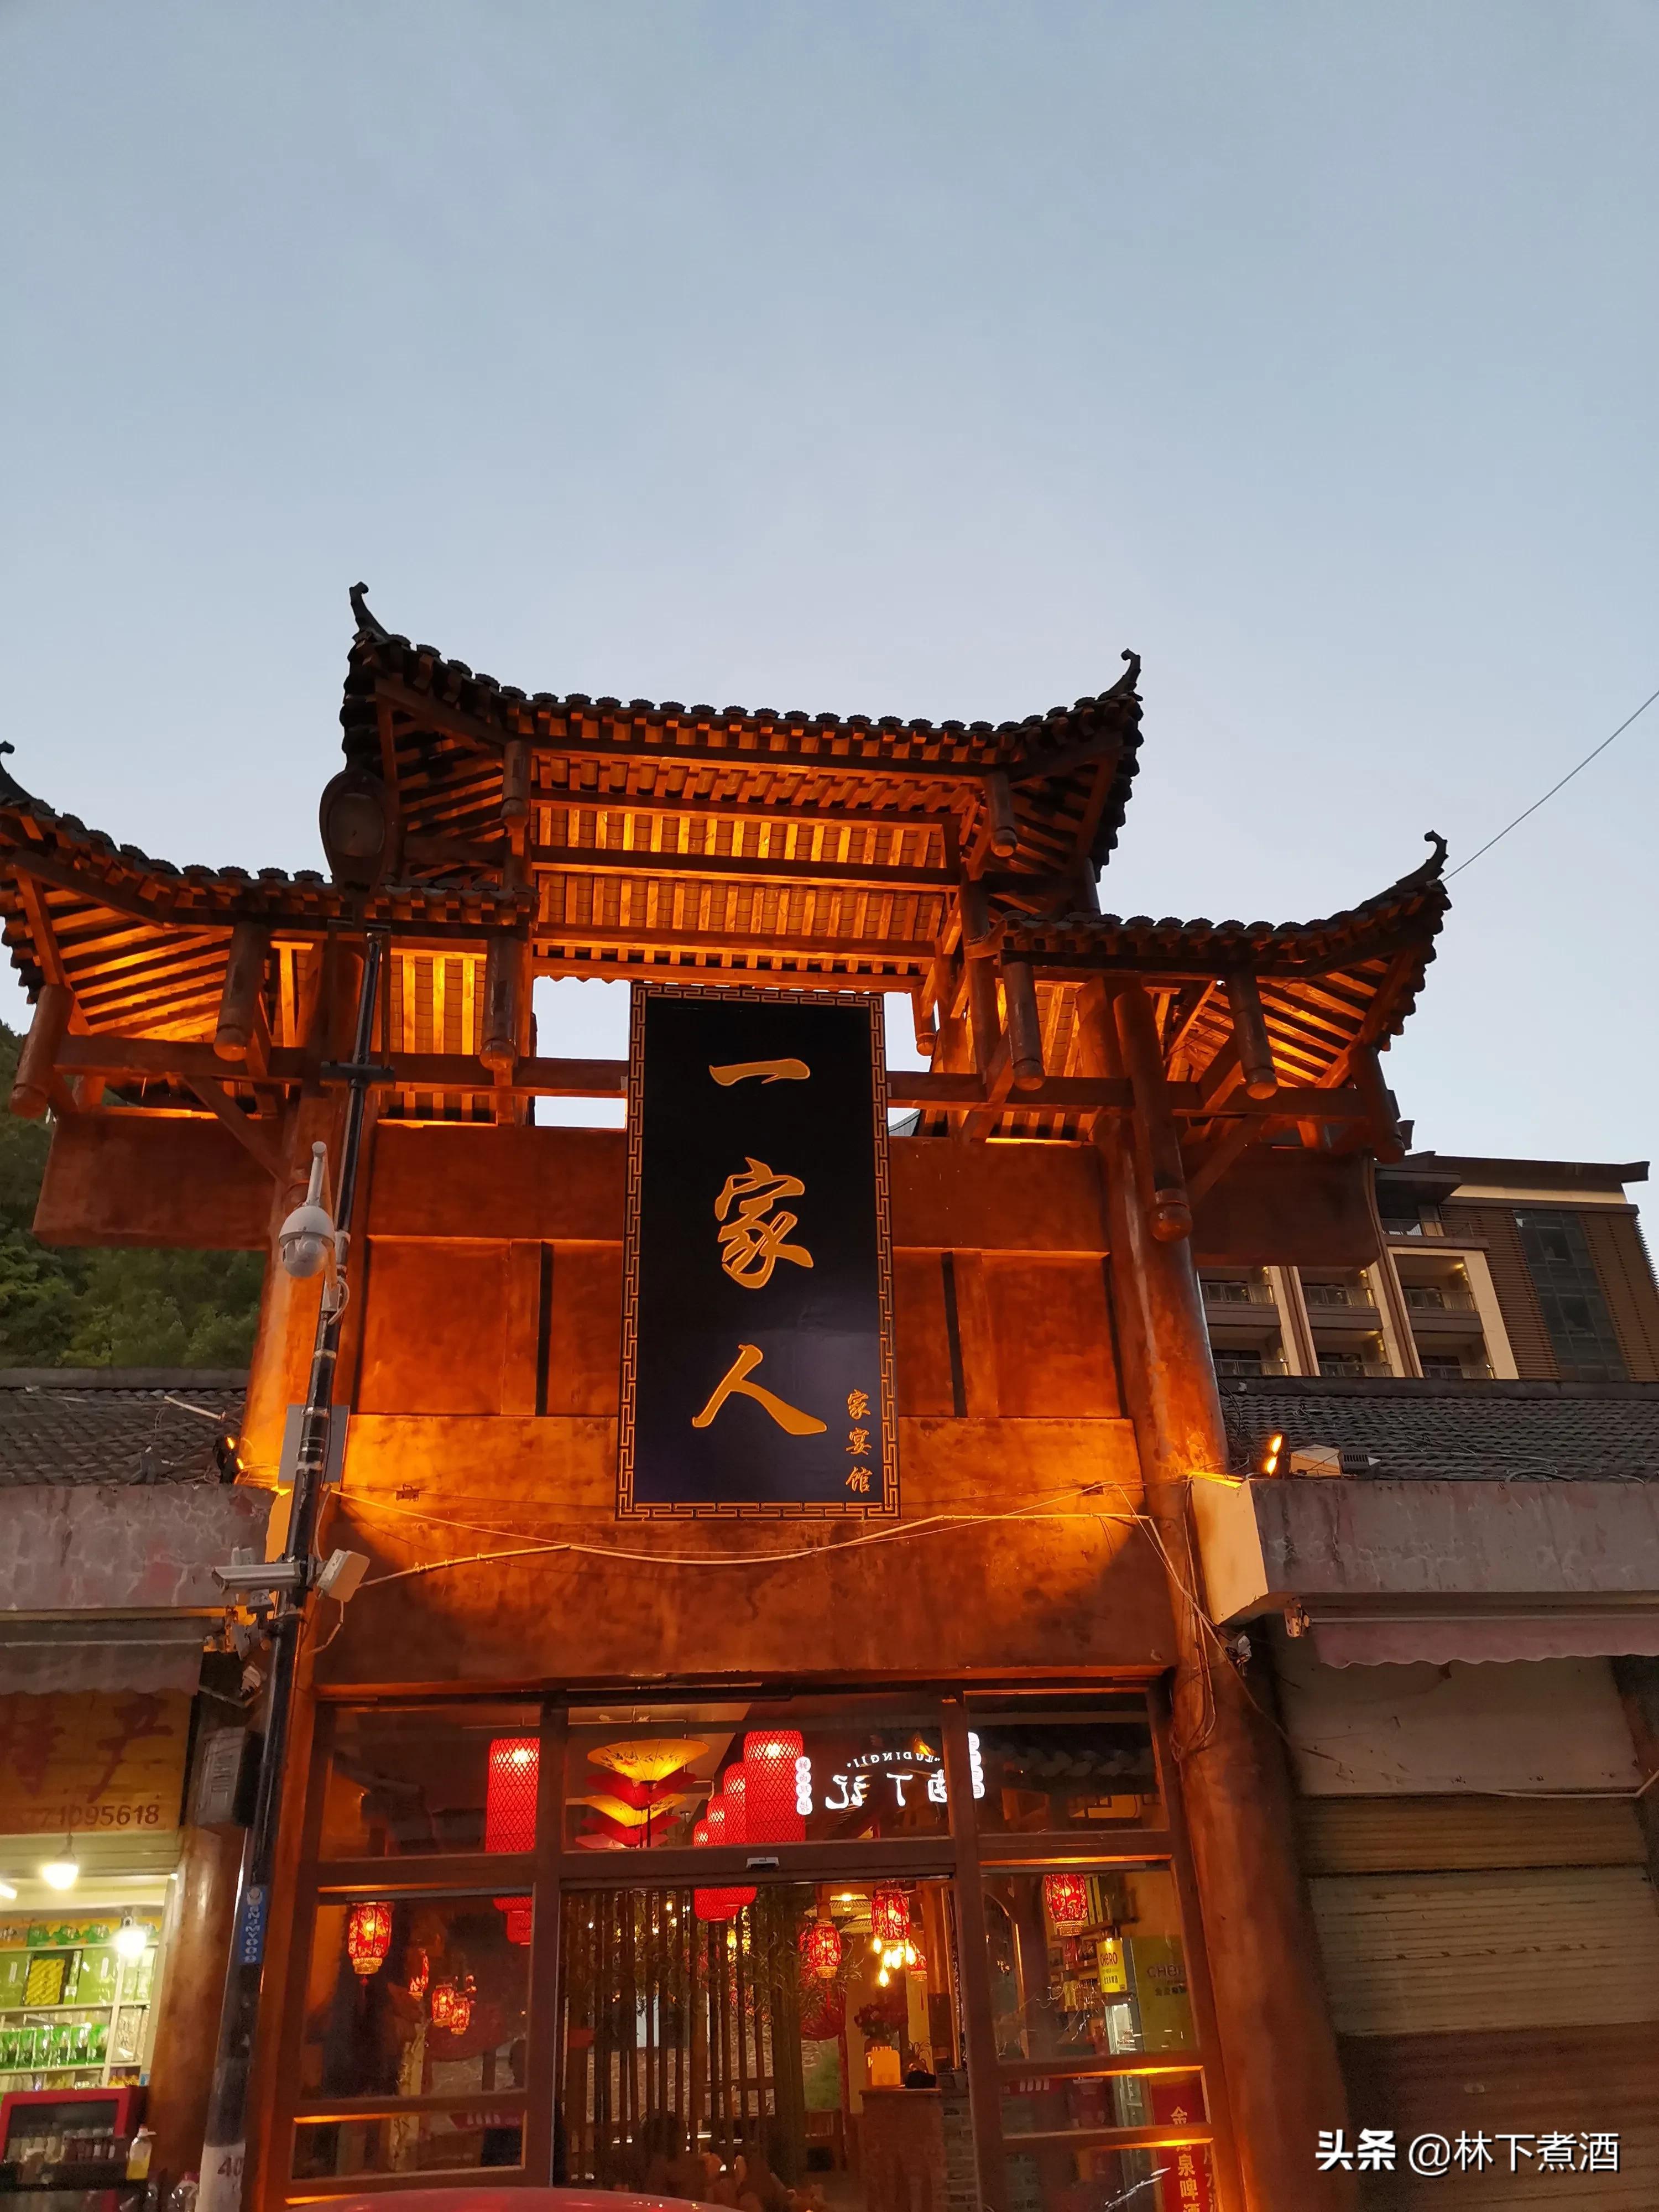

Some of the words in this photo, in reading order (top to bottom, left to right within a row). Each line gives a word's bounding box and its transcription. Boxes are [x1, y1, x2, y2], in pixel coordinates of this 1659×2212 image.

[692, 1058, 828, 1435] 一家人
[846, 1389, 873, 1493] 家宴馆
